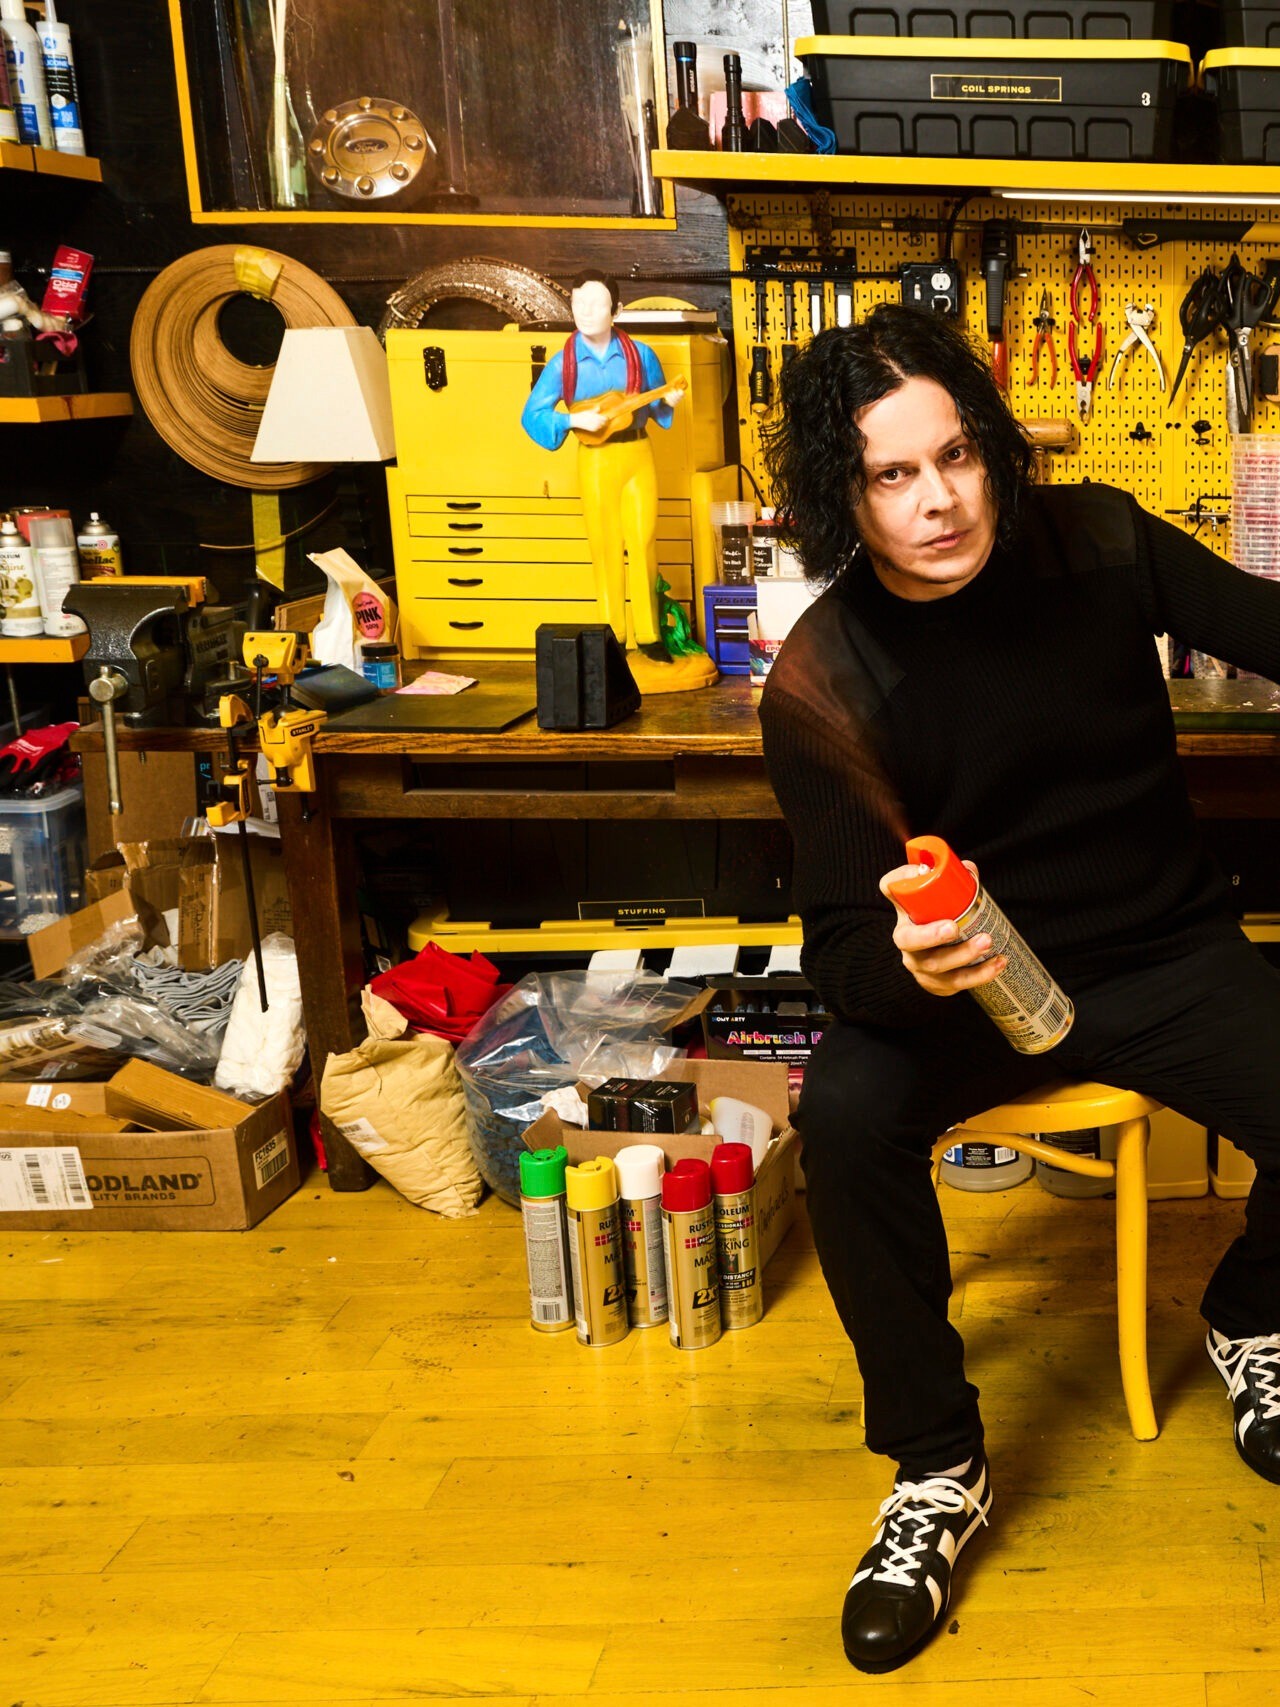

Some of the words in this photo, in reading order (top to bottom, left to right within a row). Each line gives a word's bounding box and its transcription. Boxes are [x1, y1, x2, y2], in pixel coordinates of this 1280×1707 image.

[961, 85, 985, 93] COIL
[988, 86, 1032, 94] SPRINGS
[1142, 92, 1151, 106] 3
[355, 606, 382, 625] PINK
[292, 725, 314, 736] STANLEY
[776, 878, 782, 888] 1
[726, 1030, 806, 1044] Airbrush
[94, 1192, 118, 1200] LITY
[124, 1192, 176, 1201] BRANDS
[722, 1270, 754, 1280] DISTANCE
